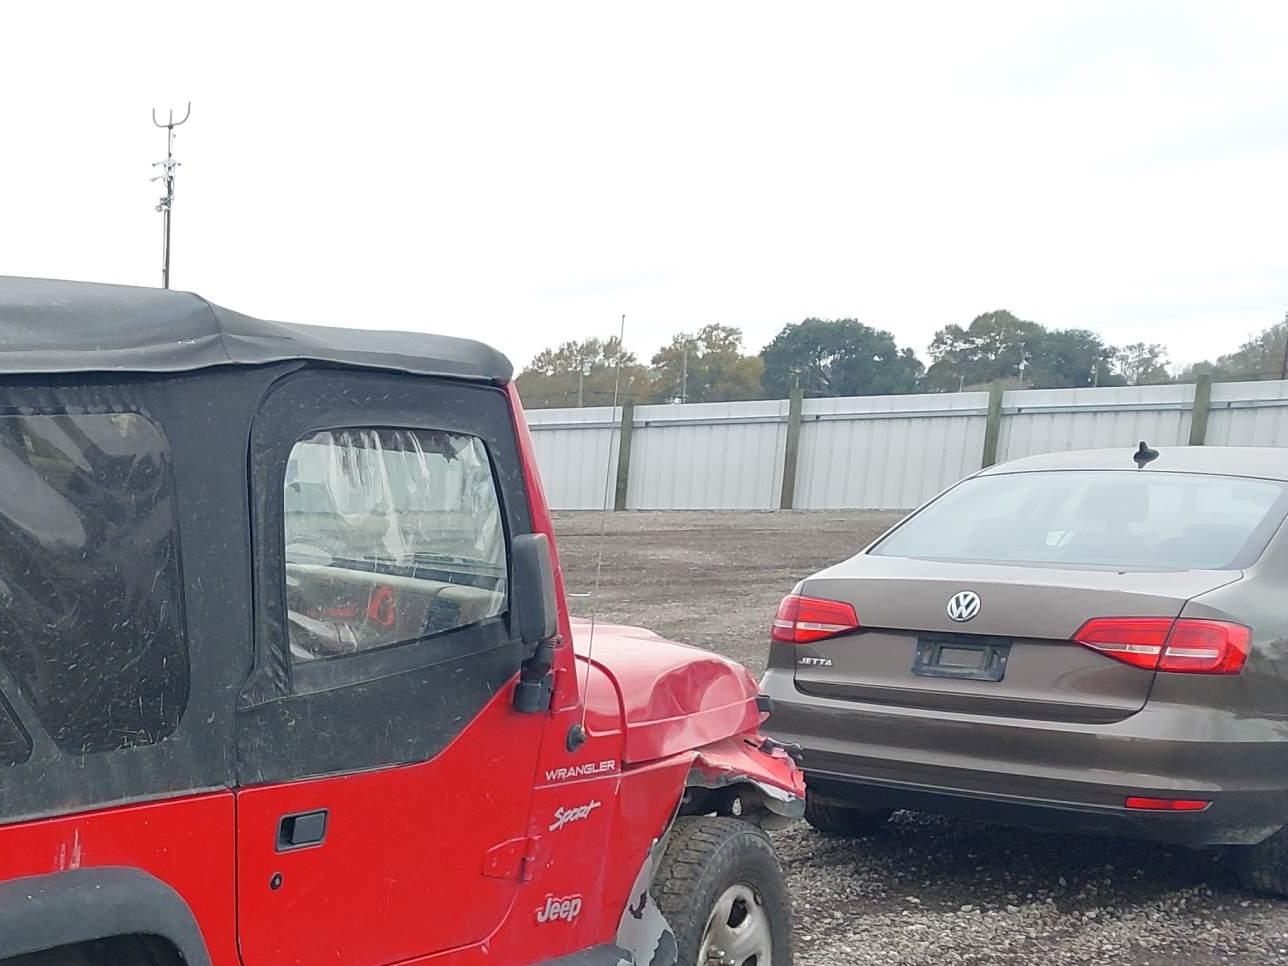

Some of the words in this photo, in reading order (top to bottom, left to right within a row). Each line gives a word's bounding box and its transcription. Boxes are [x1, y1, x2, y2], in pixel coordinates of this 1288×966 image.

[797, 656, 833, 666] JETTA
[545, 760, 616, 782] WRANGLER
[548, 799, 602, 832] Sport
[535, 893, 584, 924] Jeep
